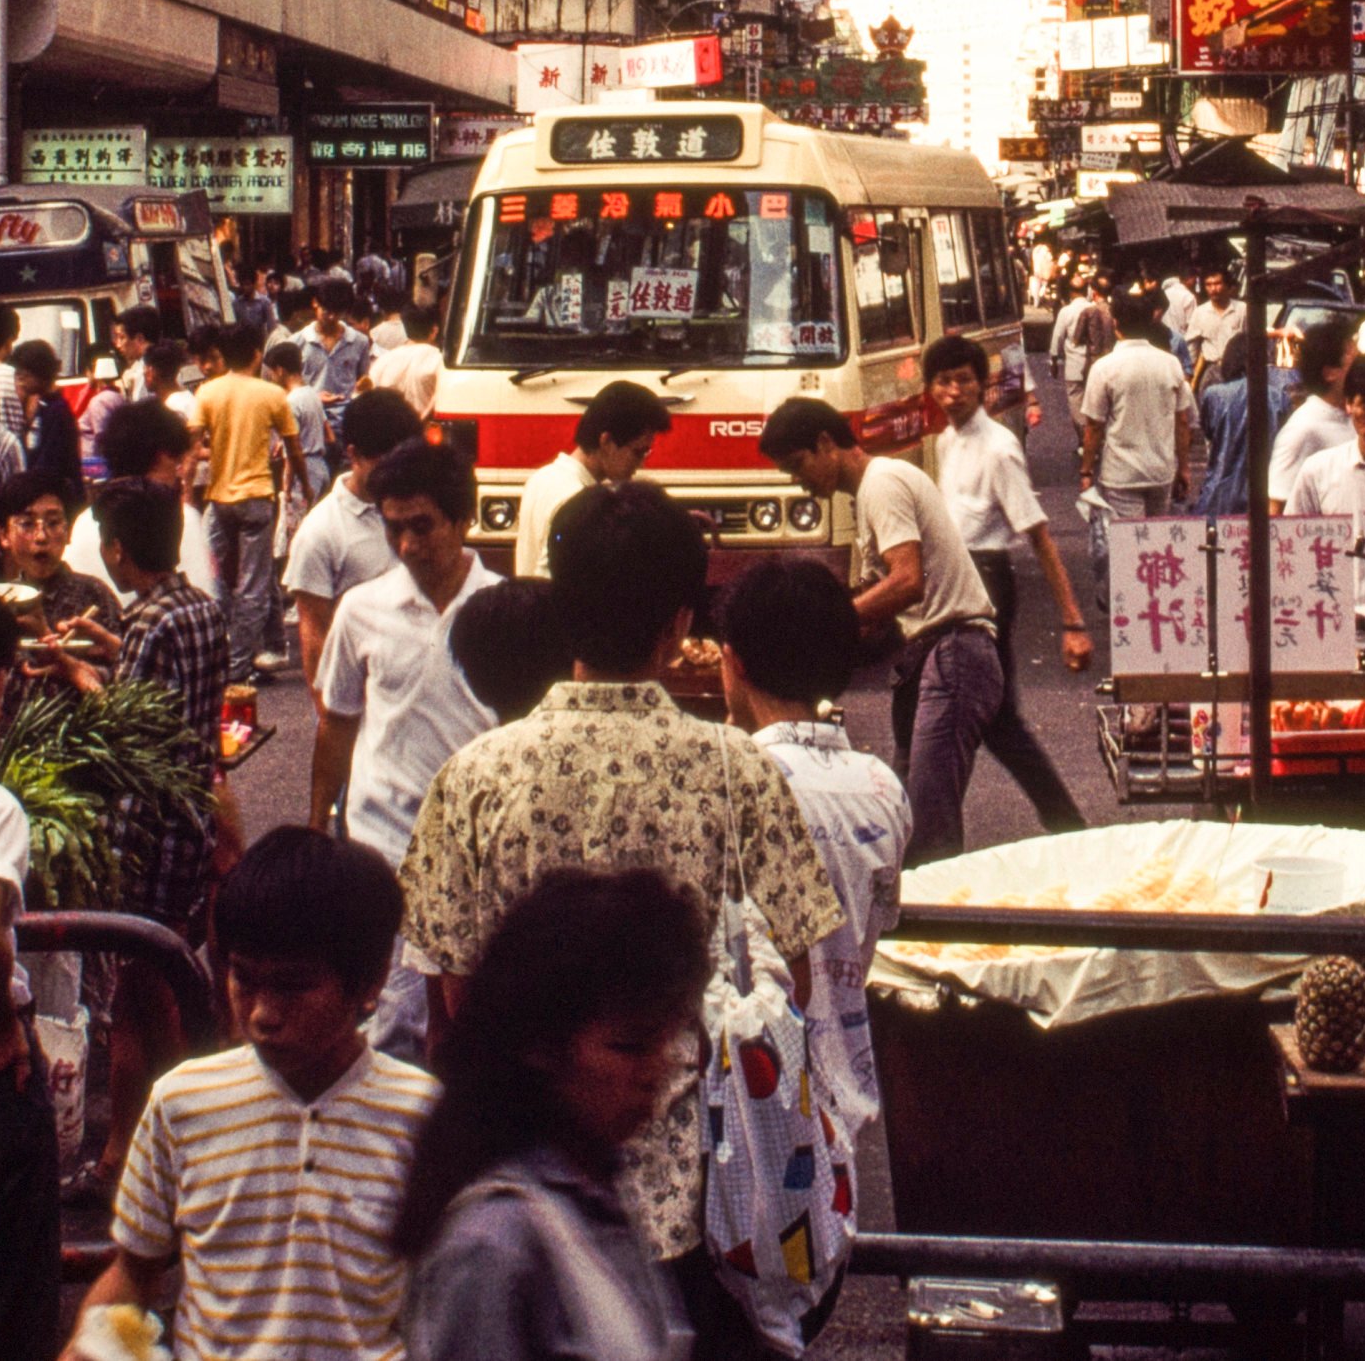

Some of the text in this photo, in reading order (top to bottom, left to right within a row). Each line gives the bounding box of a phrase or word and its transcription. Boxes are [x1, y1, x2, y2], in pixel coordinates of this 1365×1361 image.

[538, 65, 562, 89] 新
[586, 127, 709, 160] 佐敦道
[629, 280, 695, 313] 佐敦道
